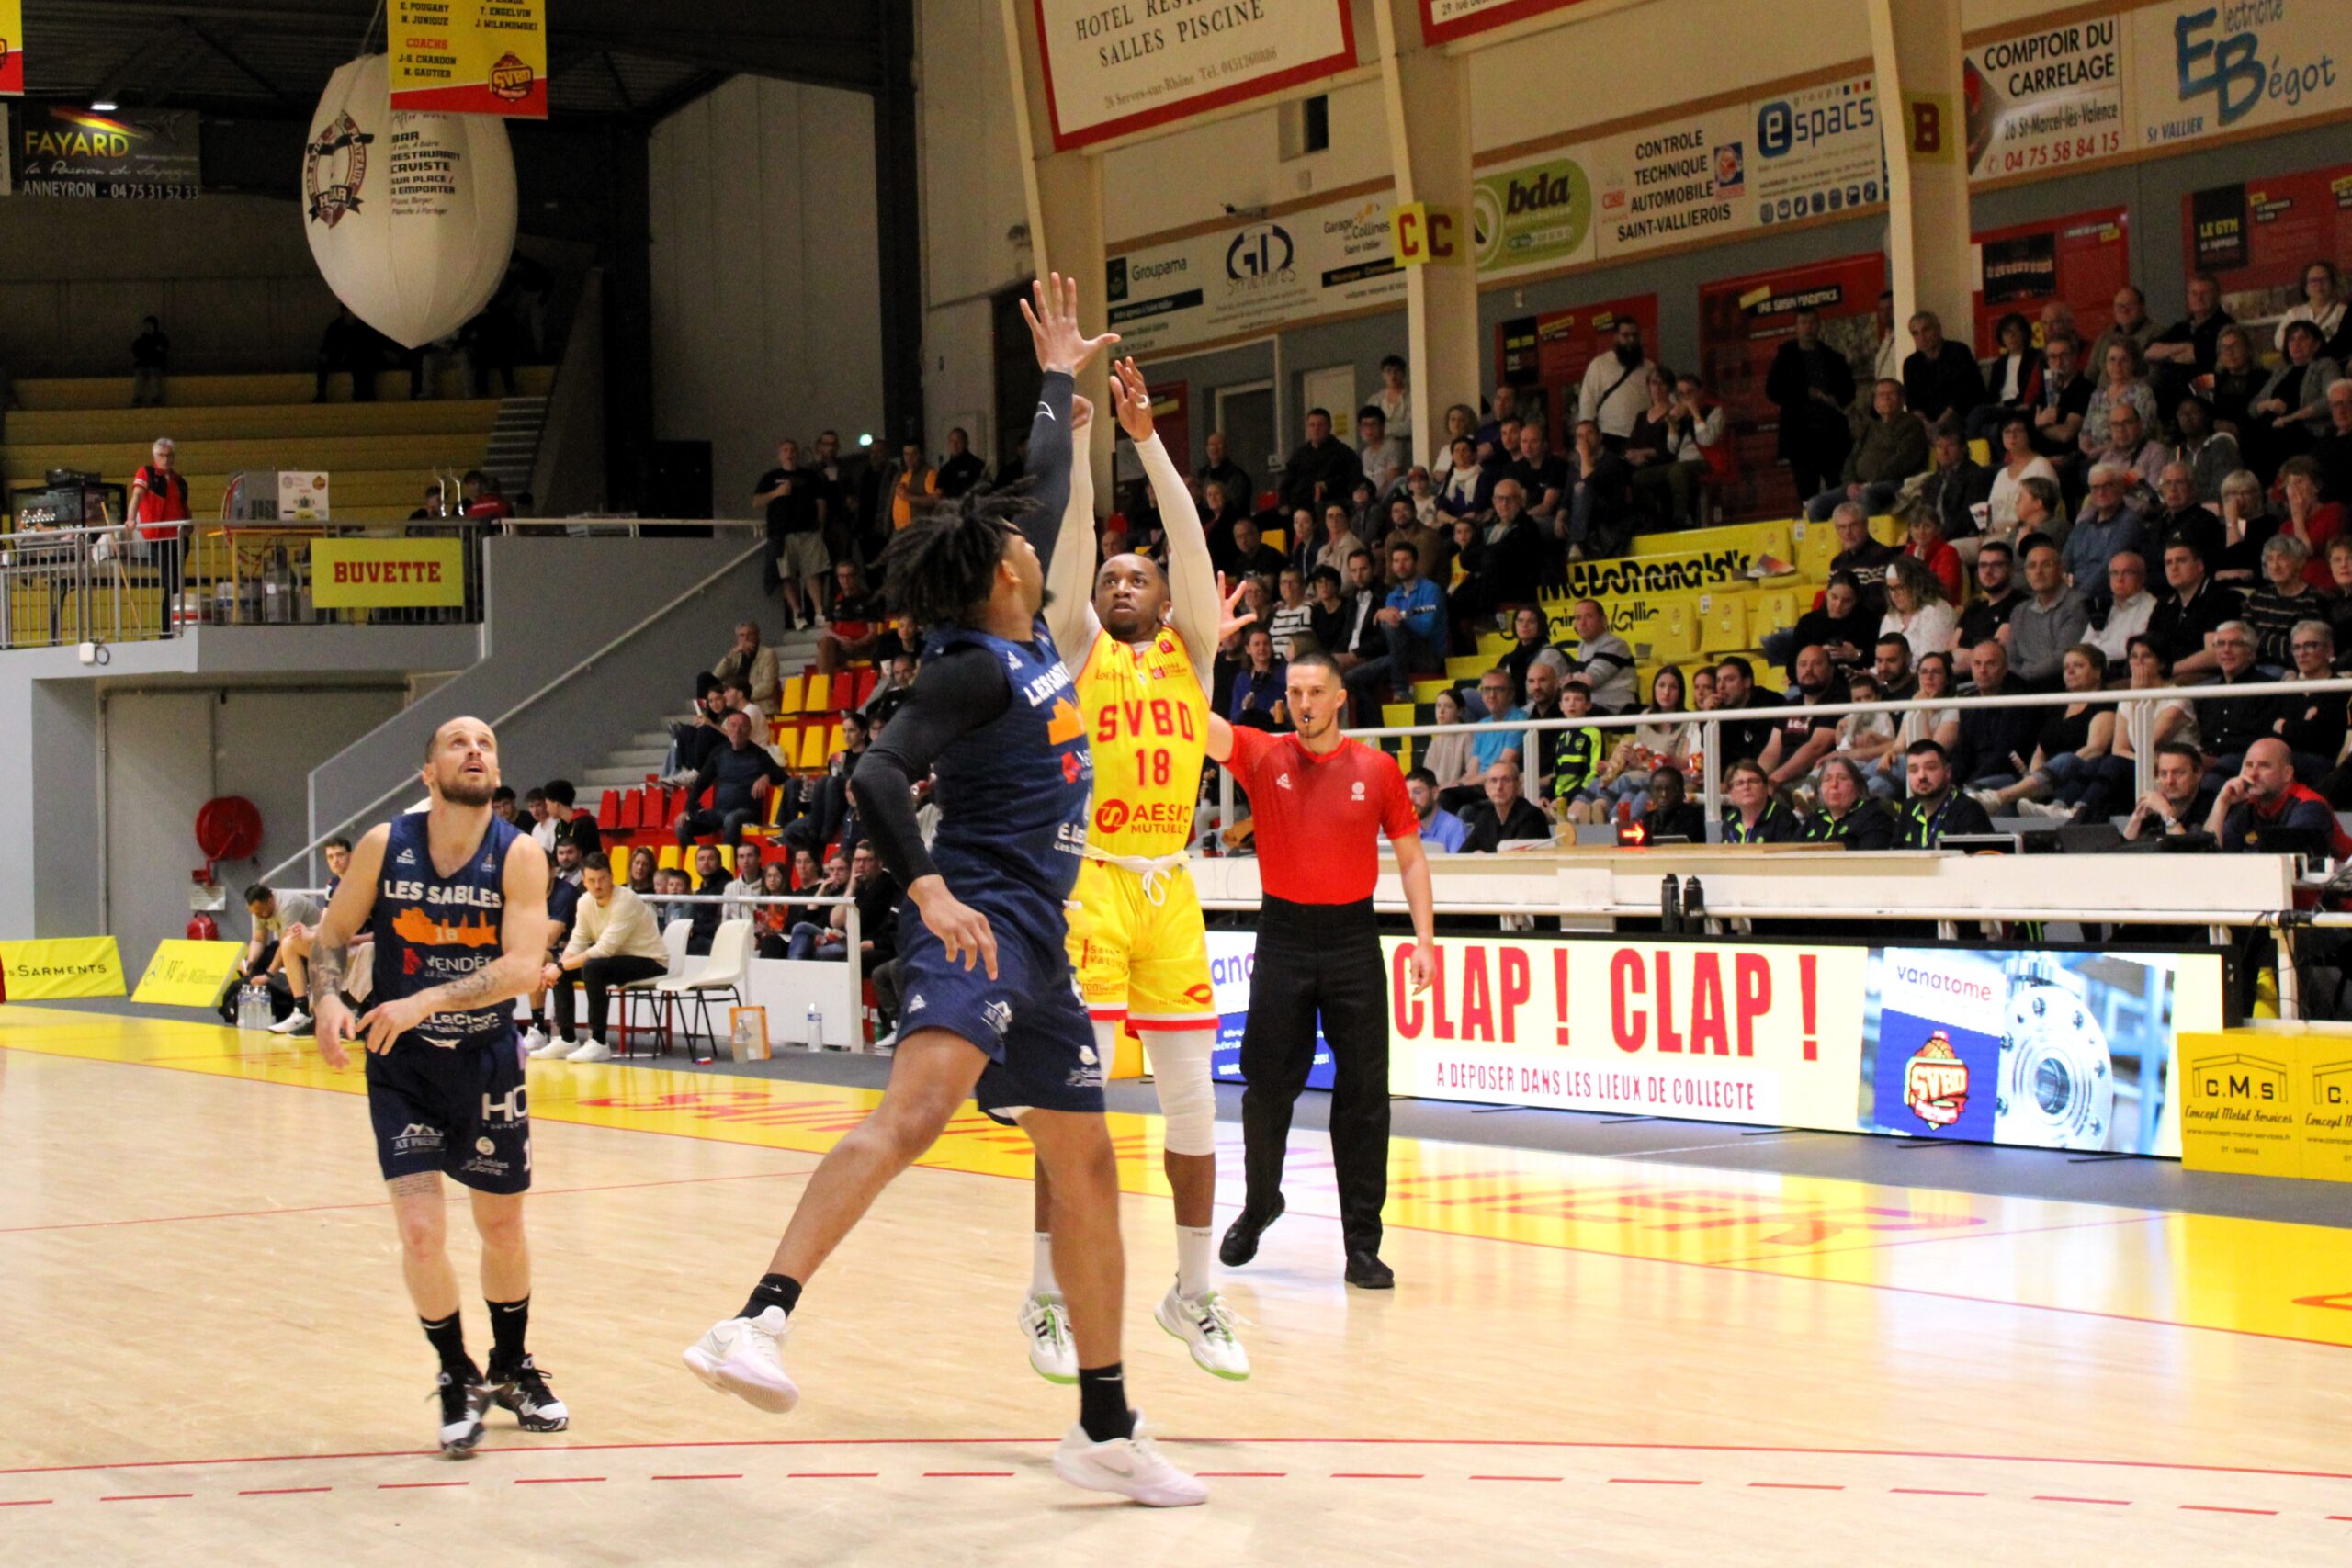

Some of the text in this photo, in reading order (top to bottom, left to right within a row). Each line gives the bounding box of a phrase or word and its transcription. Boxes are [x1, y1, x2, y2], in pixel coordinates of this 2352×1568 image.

[1075, 4, 1134, 41] HOTEL
[1099, 0, 1265, 68] SALLES PISCINE
[1984, 20, 2113, 71] COMPTOIR DU
[2008, 53, 2115, 97] CARRELAGE
[25, 130, 130, 158] FAYARD
[391, 131, 419, 143] BAR
[1912, 102, 1940, 153] B
[2162, 117, 2204, 140] VALLIER
[1635, 130, 1703, 160] CONTROLE
[2005, 130, 2120, 172] 04 75 58 84 15
[390, 162, 451, 175] CAVISTE
[413, 175, 446, 183] PLACE
[1634, 155, 1708, 186] TECHNIQUE
[23, 180, 96, 197] ANNEYRON
[111, 184, 127, 197] 04
[130, 184, 145, 198] 75
[148, 185, 162, 198] 31
[166, 185, 182, 199] 52
[185, 185, 199, 199] 33
[399, 186, 456, 195] EMPORTER
[1507, 173, 1571, 216] bda
[1631, 180, 1715, 213] AUTOMOBILE
[1398, 212, 1419, 257] C
[1427, 214, 1453, 257] C
[1618, 203, 1732, 242] SAINT-VALLIEROIS
[1131, 256, 1188, 283] Groupama
[334, 561, 442, 583] BUVETTE
[1097, 699, 1194, 743] SVBD
[1136, 748, 1170, 787] 18
[384, 880, 503, 908] LES SABLES
[435, 927, 458, 942] 18
[17, 964, 107, 977] SARMENTS
[1896, 965, 1992, 1001] vanatome
[1392, 942, 1818, 1061] CLAP ! CLAP !
[1437, 1062, 1445, 1087] A
[1521, 1067, 1560, 1095] DANS
[1567, 1070, 1592, 1097] LES
[1598, 1073, 1641, 1101] LIEUX
[1648, 1077, 1667, 1103] DE
[1673, 1078, 1755, 1111] COLLECTE
[1911, 1066, 1969, 1104] SVBD
[2185, 1105, 2293, 1123] Concept Metal Services
[2305, 1113, 2341, 1129] Concept
